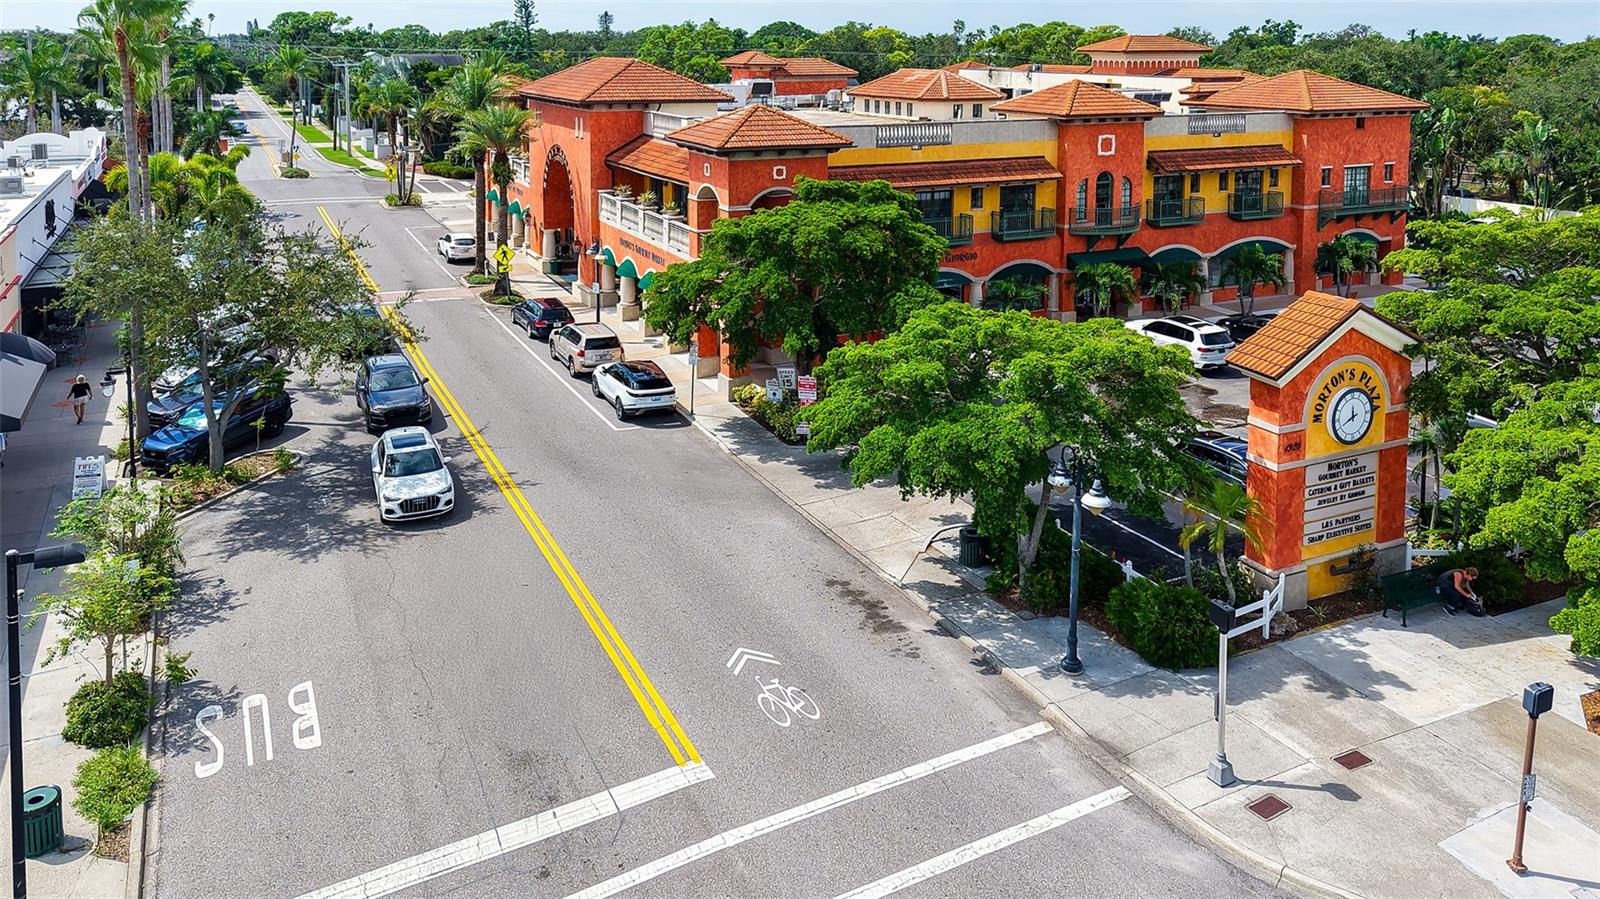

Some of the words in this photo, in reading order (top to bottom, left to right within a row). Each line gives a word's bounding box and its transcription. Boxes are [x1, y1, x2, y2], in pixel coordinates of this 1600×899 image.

[782, 379, 793, 387] 15
[1312, 368, 1356, 423] MORTON'S
[1358, 370, 1381, 413] PLAZA
[1317, 470, 1343, 481] GOURMET
[1345, 465, 1367, 476] MARKET
[1327, 458, 1359, 472] MORTON'S
[1308, 485, 1332, 496] CATERING
[1339, 480, 1351, 489] GIFT
[1352, 475, 1375, 487] BASKETS
[1316, 496, 1338, 506] JEWELRY
[1334, 514, 1361, 526] PARTNERS
[1307, 534, 1325, 544] SHARP
[1325, 526, 1353, 539] EXECUTIVE
[1354, 522, 1372, 532] SUITES
[194, 680, 322, 779] BUS
